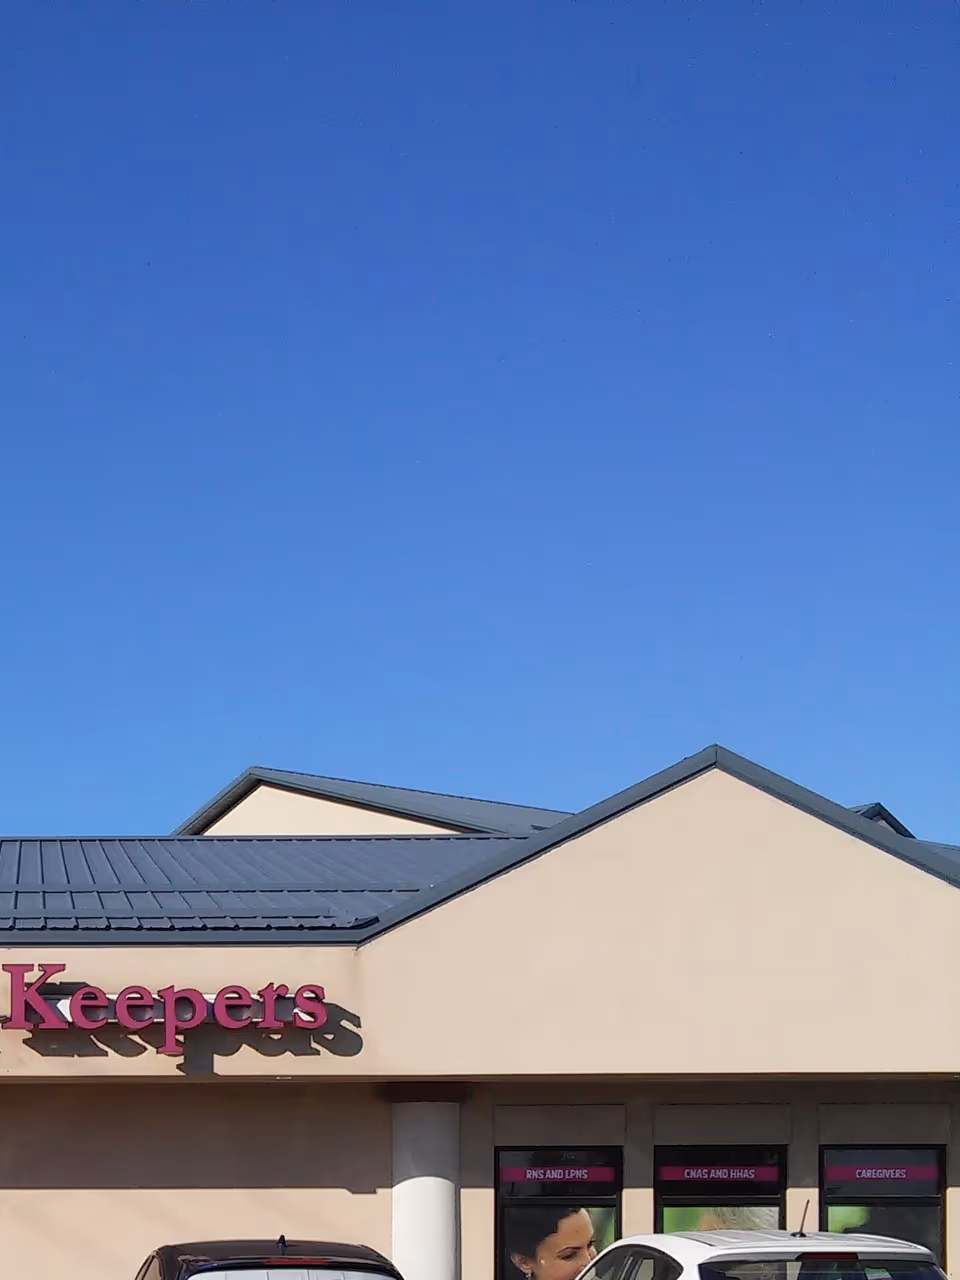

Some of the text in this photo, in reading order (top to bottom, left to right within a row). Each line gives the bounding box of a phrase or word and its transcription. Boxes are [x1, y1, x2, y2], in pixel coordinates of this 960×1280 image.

[0, 962, 329, 1055] Keepers
[526, 1169, 588, 1179] RNS AND LPNS
[684, 1168, 755, 1179] CNAS AND HHAS
[855, 1168, 907, 1179] CAREGIVERS
